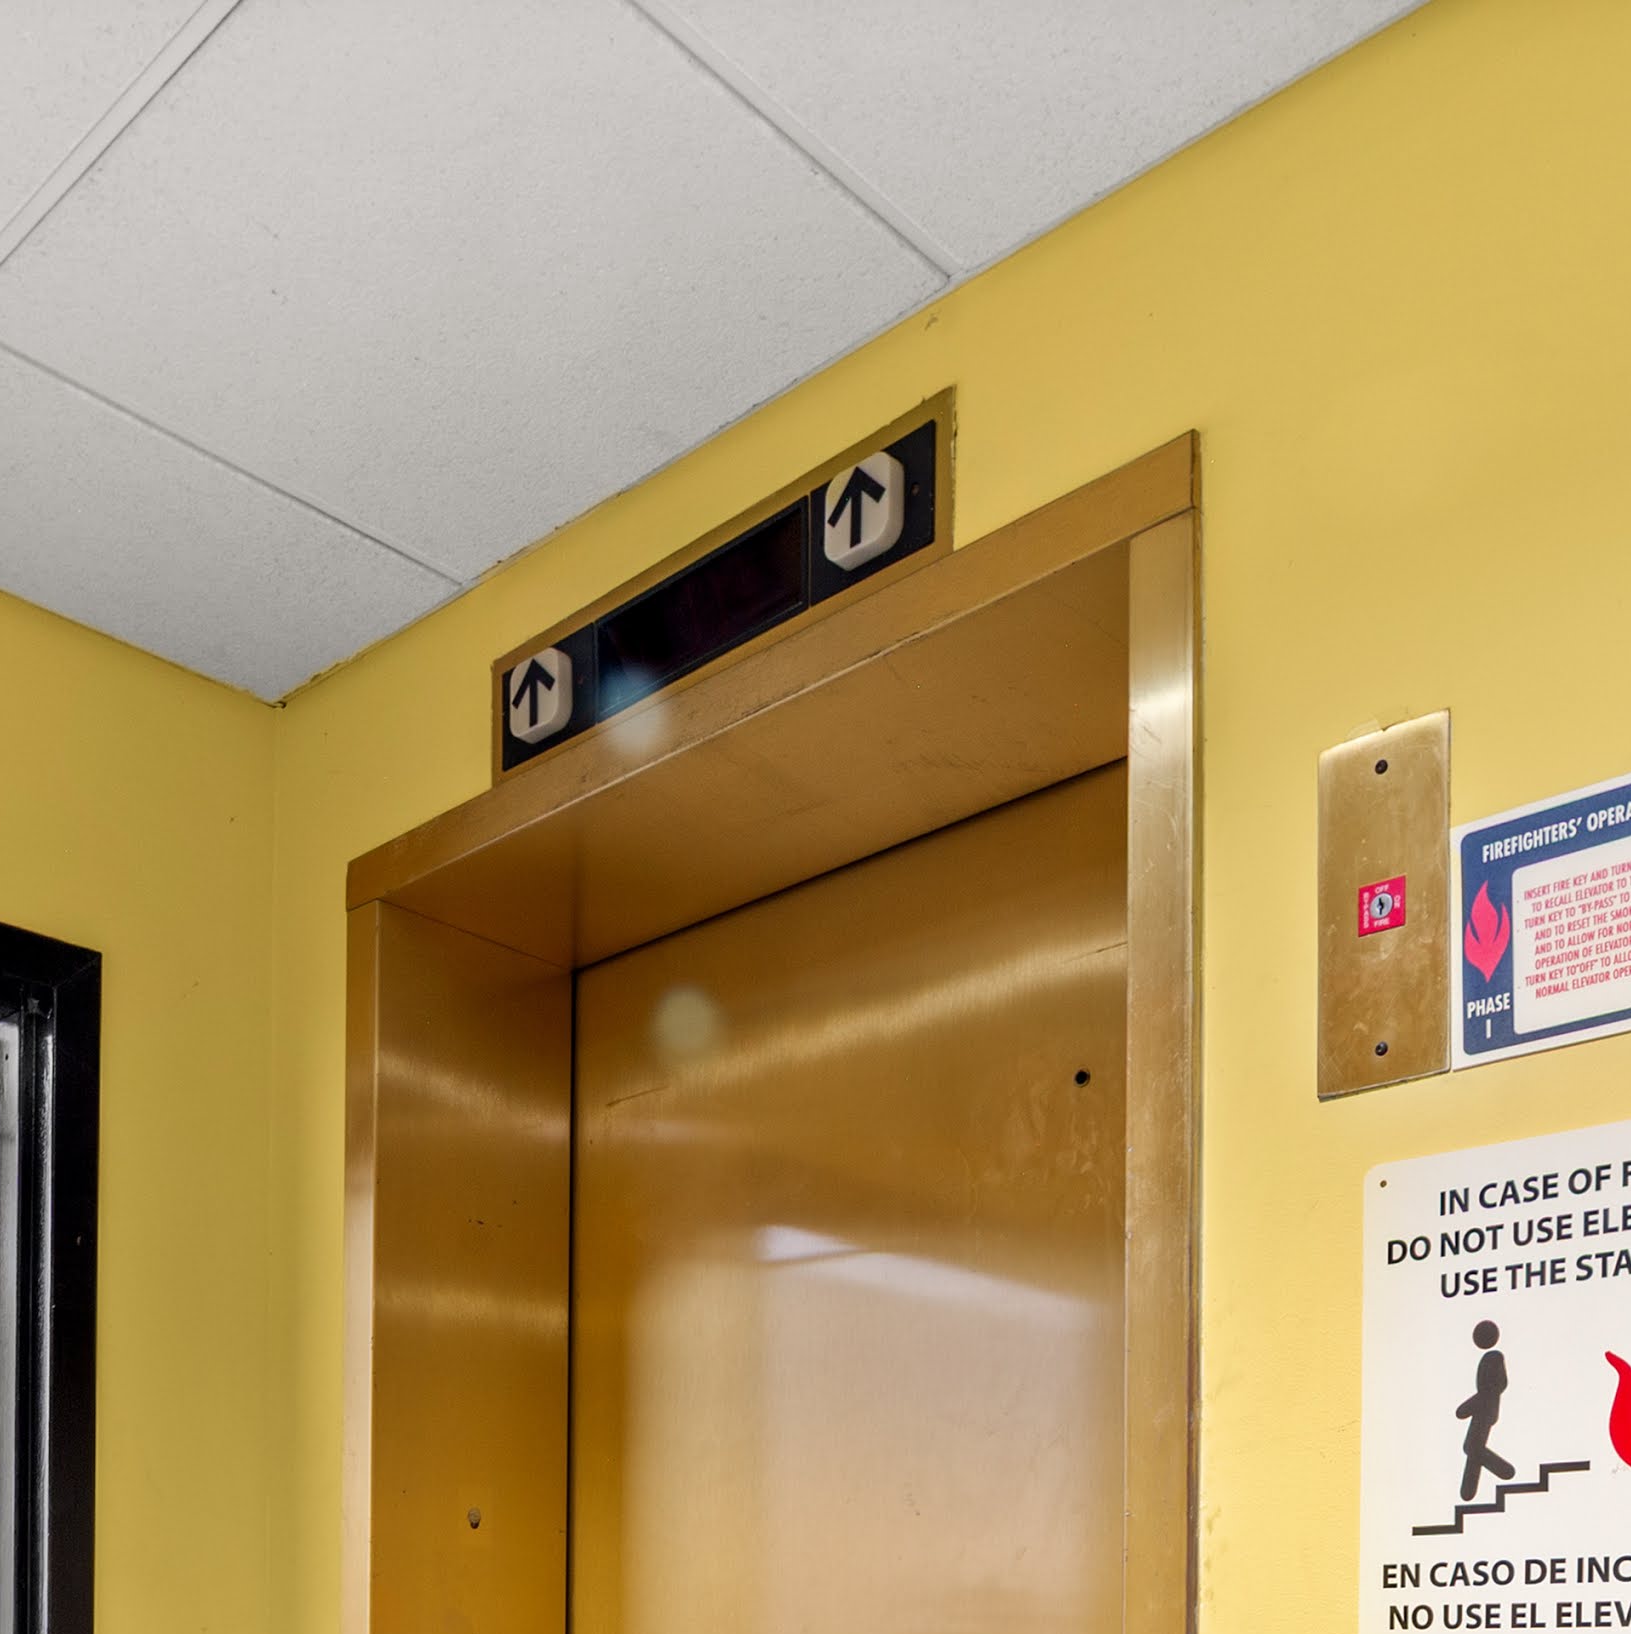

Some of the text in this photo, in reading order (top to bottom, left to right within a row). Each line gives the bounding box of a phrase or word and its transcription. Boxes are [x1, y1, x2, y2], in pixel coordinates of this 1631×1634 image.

[1482, 816, 1582, 863] FIREFIGHTERS'
[1524, 884, 1550, 900] INSERT
[1553, 879, 1570, 892] FIRE
[1573, 874, 1587, 887] KEY
[1590, 869, 1608, 882] AND
[1531, 902, 1542, 912] TO
[1545, 893, 1571, 909] RECALL
[1576, 881, 1613, 900] ELEVATOR
[1617, 878, 1628, 889] TO
[1525, 915, 1545, 929] TURN
[1549, 910, 1562, 923] KEY
[1566, 906, 1576, 917] TO
[1620, 891, 1630, 903] TO
[1535, 928, 1551, 941] AND
[1555, 925, 1565, 935] TO
[1568, 917, 1590, 931] RESET
[1593, 913, 1607, 926] THE
[1535, 942, 1551, 955] AND
[1555, 939, 1565, 950] TO
[1568, 931, 1594, 946] ALLOW
[1598, 926, 1613, 938] FOR
[1525, 972, 1546, 987] TURN
[1549, 968, 1563, 981] KEY
[1601, 955, 1611, 967] TO
[1535, 951, 1579, 970] OPERATION
[1582, 946, 1593, 957] OF
[1535, 983, 1568, 999] NORMAL
[1572, 972, 1610, 989] ELEVATOR
[1467, 993, 1510, 1018] PHASE
[1440, 1187, 1470, 1217] IN
[1479, 1175, 1559, 1210] CASE
[1568, 1165, 1612, 1196] OF
[1386, 1236, 1432, 1265] DO
[1440, 1225, 1504, 1258] NOT
[1513, 1215, 1574, 1249] USE
[1441, 1268, 1499, 1299] USE
[1506, 1258, 1566, 1291] THE
[1382, 1563, 1420, 1590] EN
[1429, 1560, 1515, 1587] CASO
[1524, 1558, 1567, 1584] DE
[1389, 1604, 1434, 1630] NO
[1443, 1603, 1501, 1629] USE
[1510, 1602, 1546, 1628] EL
